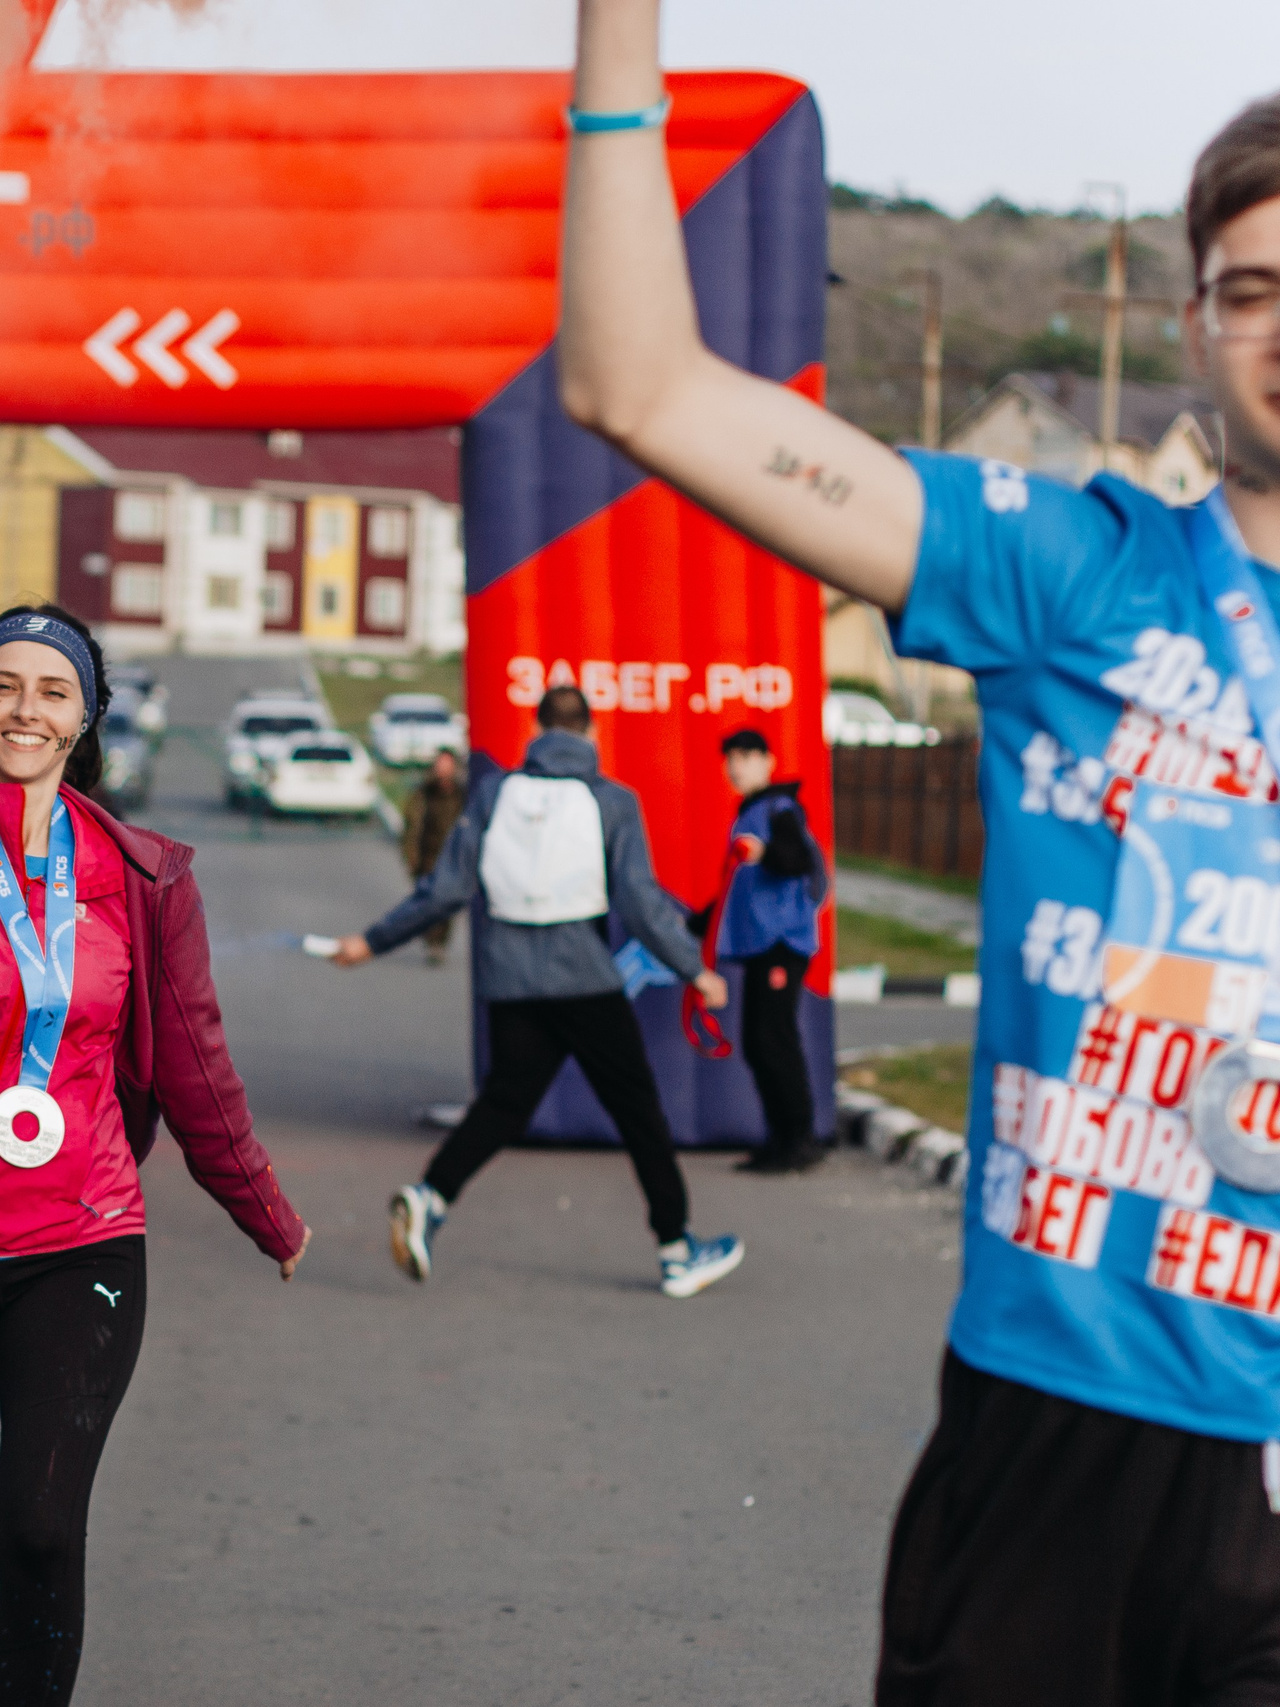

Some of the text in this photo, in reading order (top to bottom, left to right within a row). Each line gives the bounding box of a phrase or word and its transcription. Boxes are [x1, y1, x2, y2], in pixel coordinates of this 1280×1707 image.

[506, 656, 792, 714] ЗАБЕГ.РФ
[54, 855, 68, 880] ПСБ
[1177, 867, 1280, 956] 20
